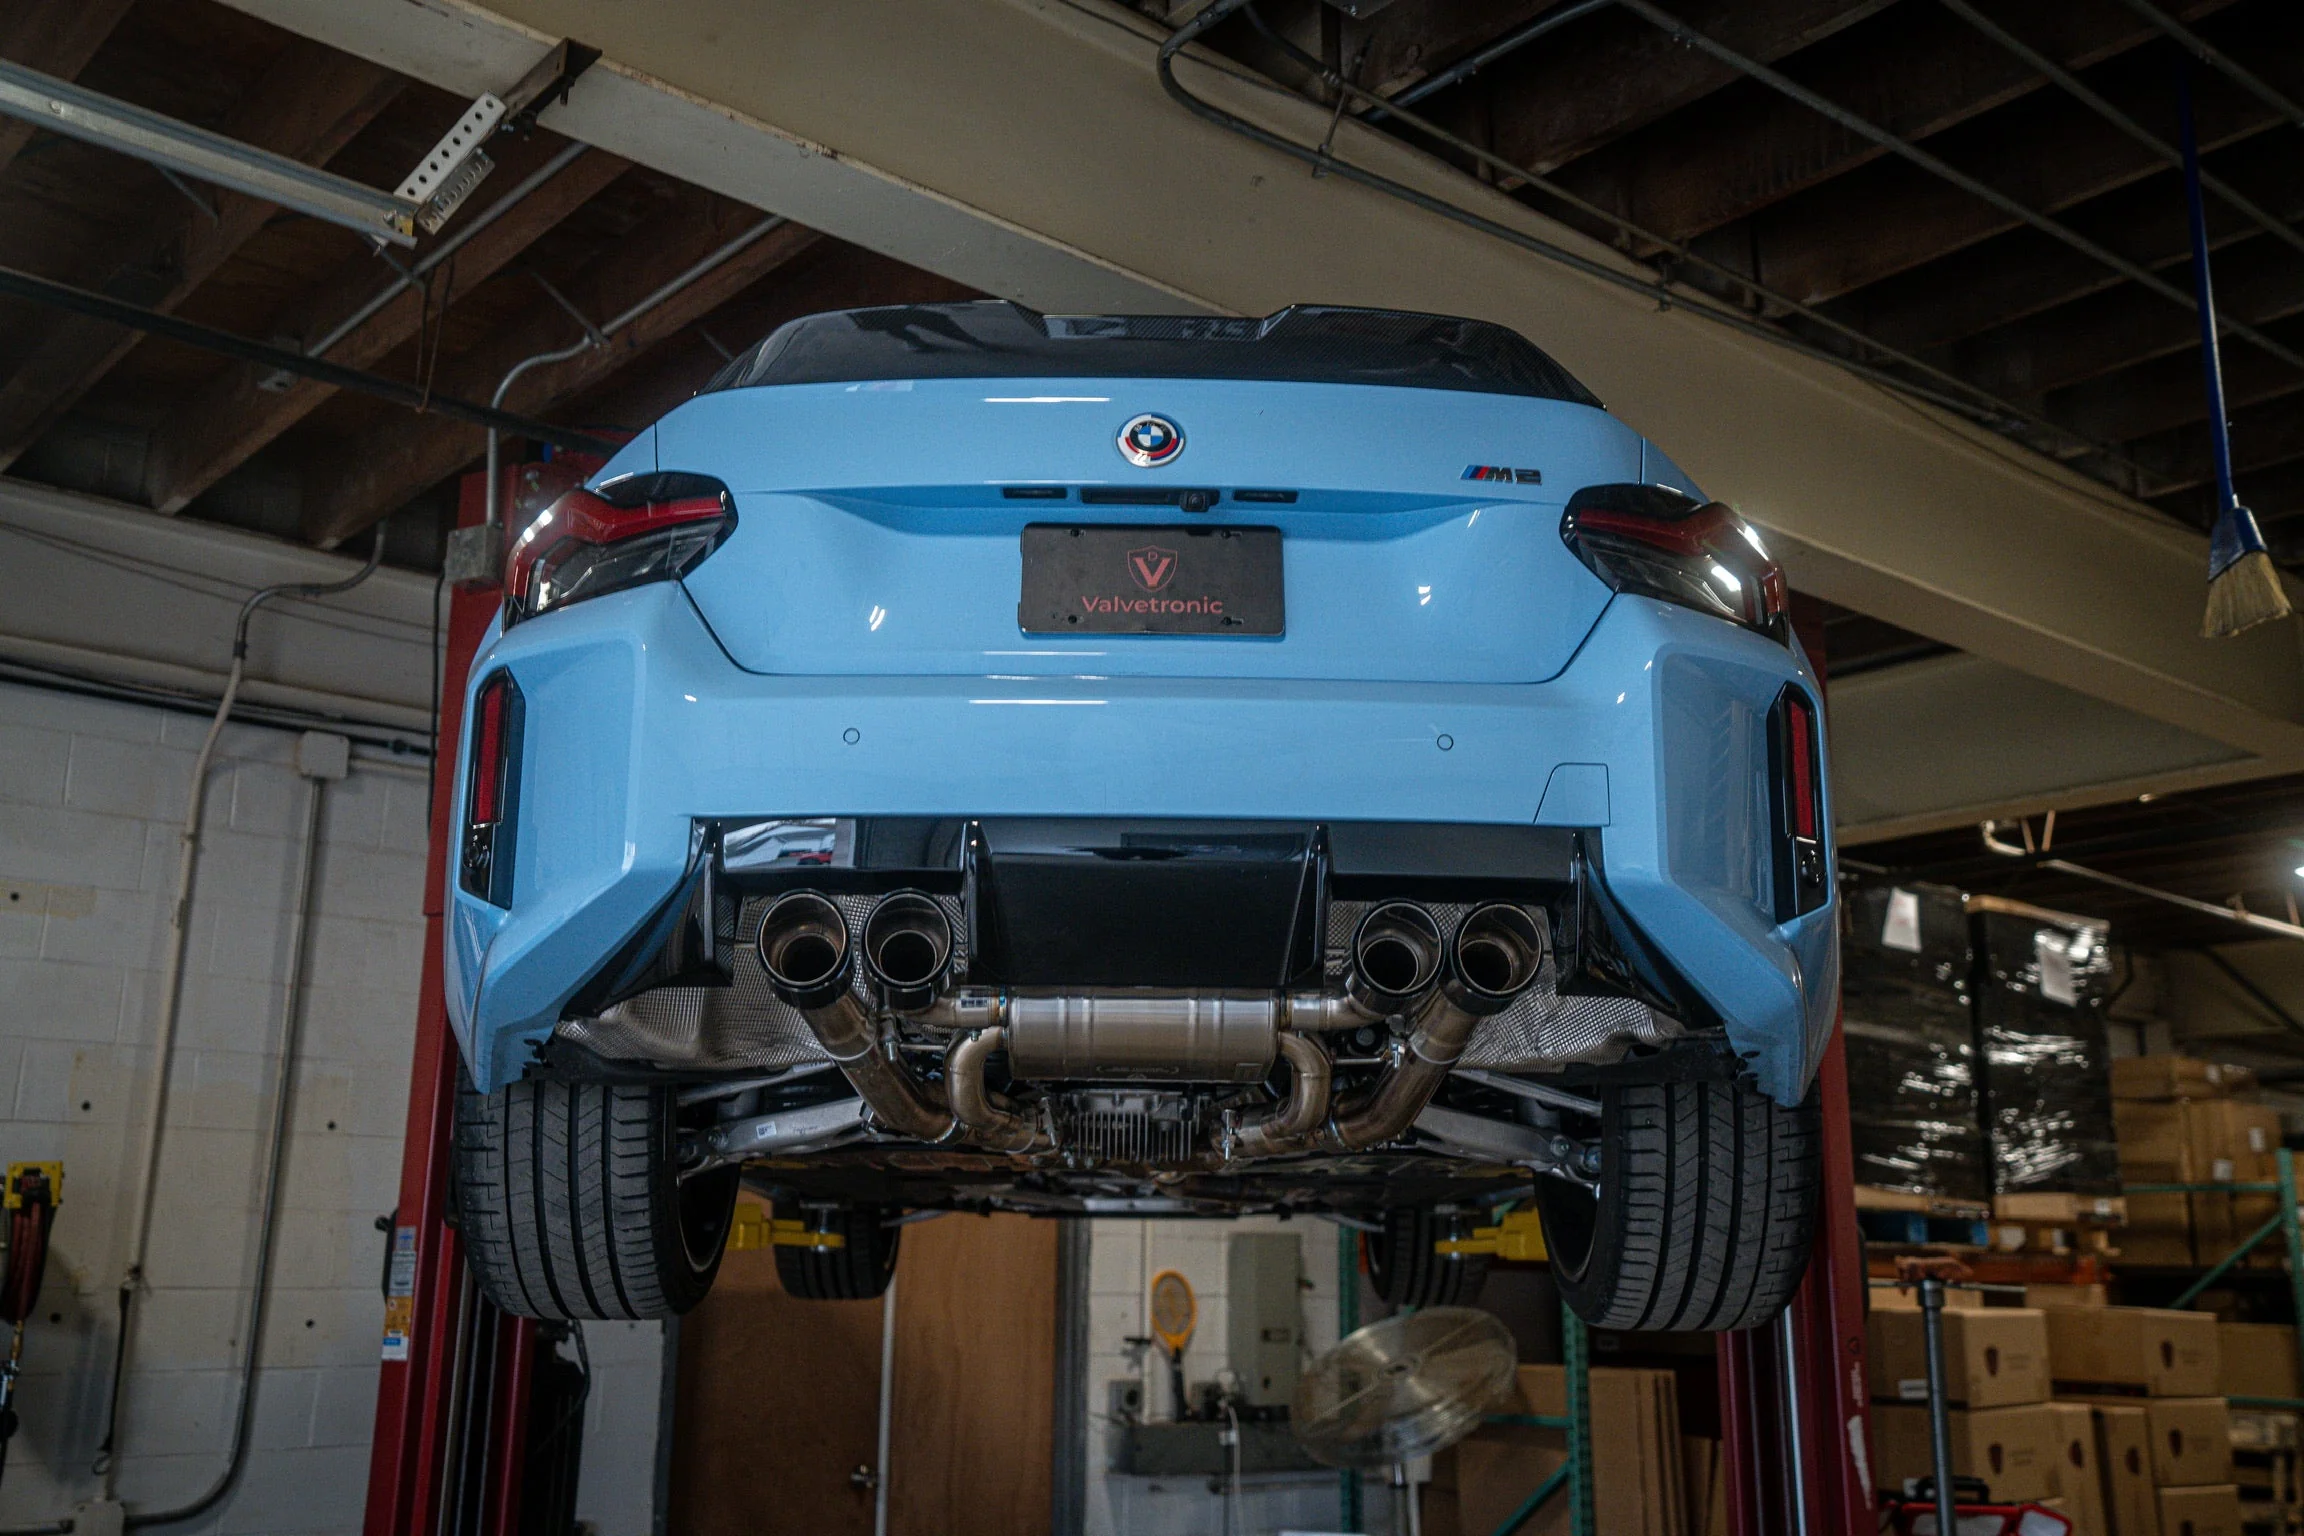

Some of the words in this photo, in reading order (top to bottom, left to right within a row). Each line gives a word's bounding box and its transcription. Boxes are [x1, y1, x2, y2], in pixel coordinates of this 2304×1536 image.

[1483, 465, 1542, 485] M2
[1133, 557, 1172, 586] V
[1081, 596, 1223, 614] Valvetronic
